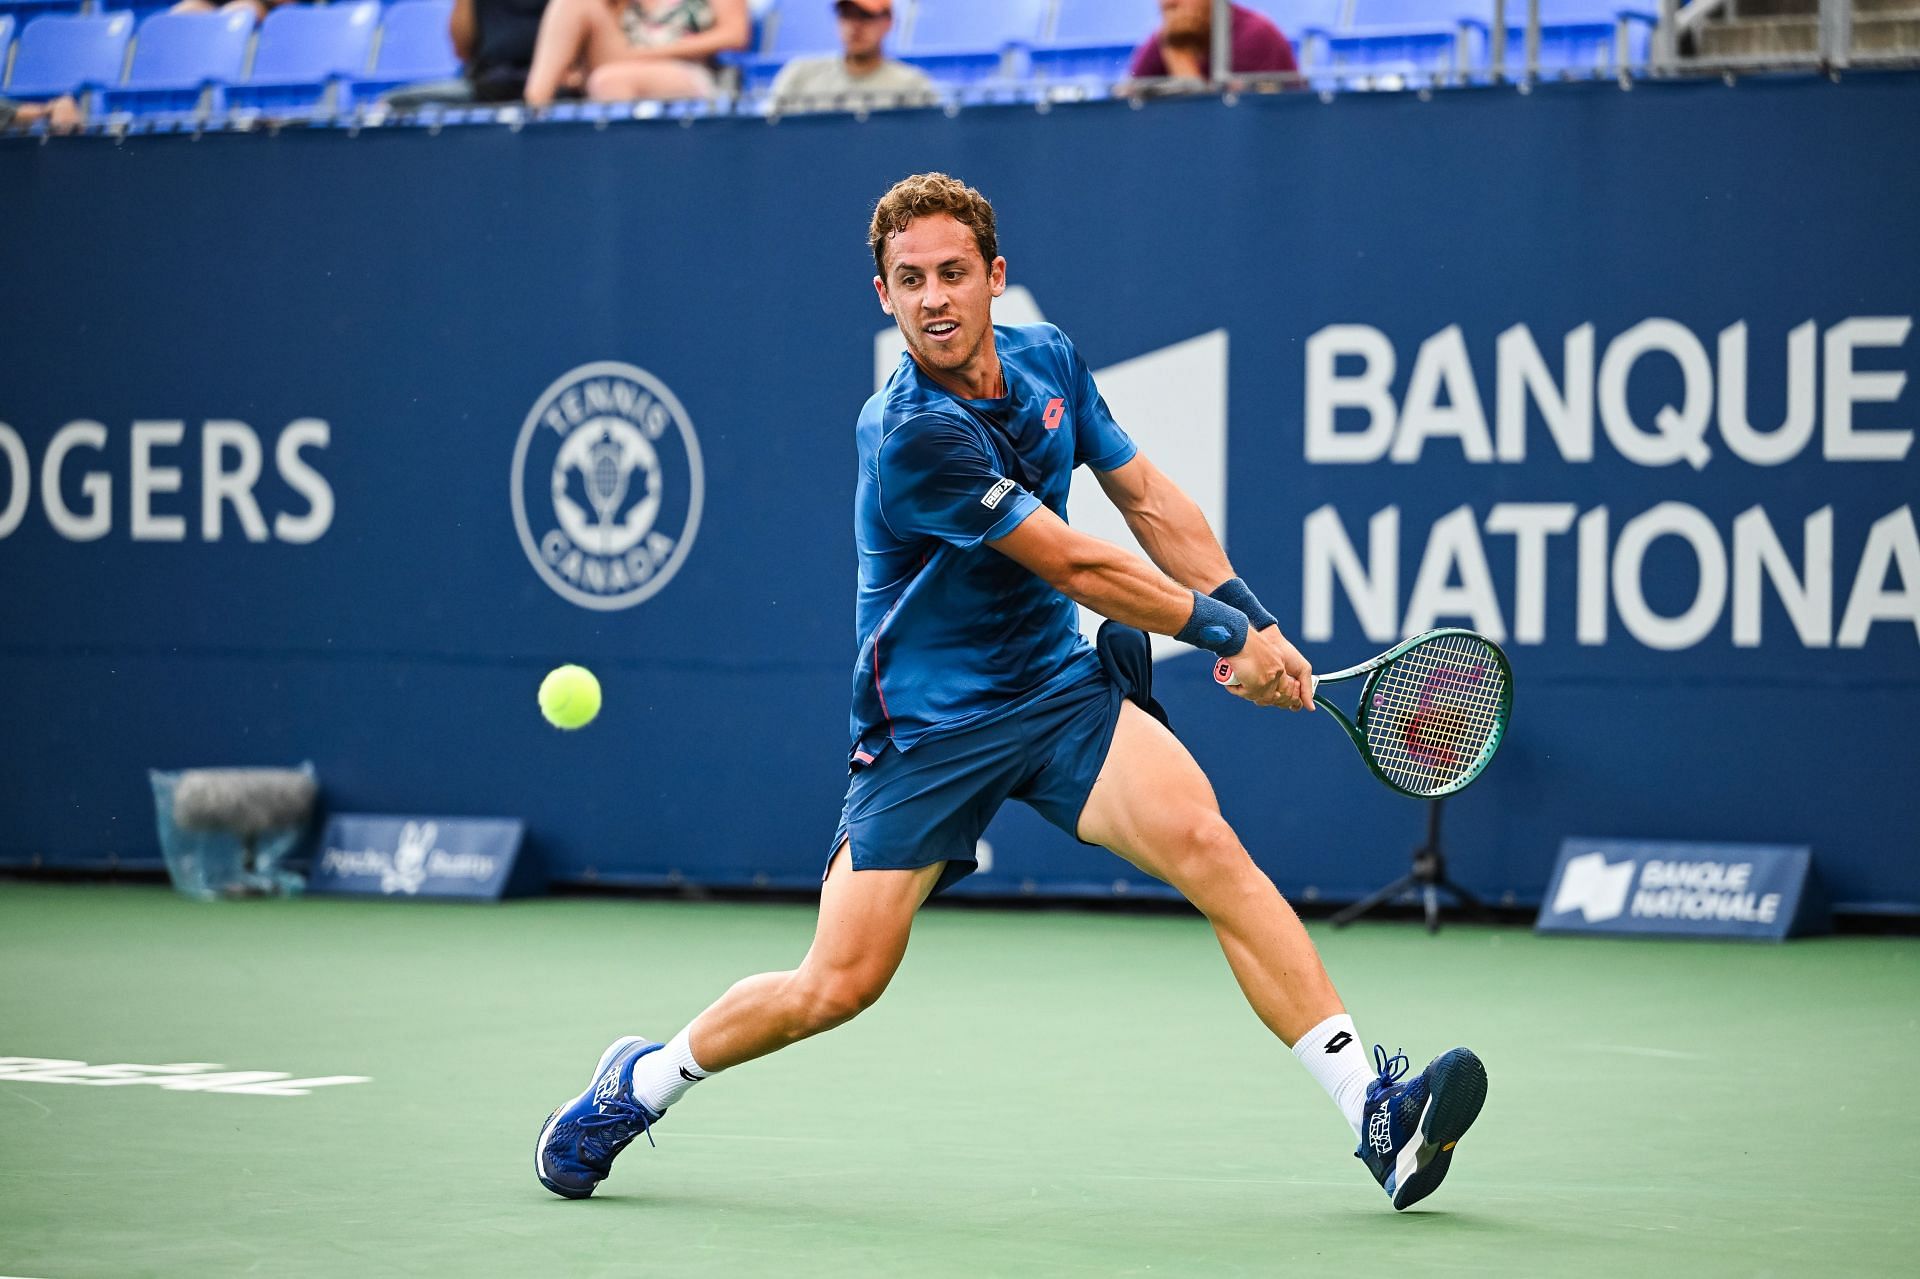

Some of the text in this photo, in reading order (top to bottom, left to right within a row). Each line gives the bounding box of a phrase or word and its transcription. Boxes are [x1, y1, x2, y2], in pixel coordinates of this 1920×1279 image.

[542, 377, 672, 440] TENNIS
[1304, 317, 1914, 470] BANQUE
[541, 529, 674, 594] CANADA
[1302, 501, 1920, 650] NATIONA
[1630, 885, 1782, 924] NATIONALE
[1639, 859, 1753, 890] BANQUE
